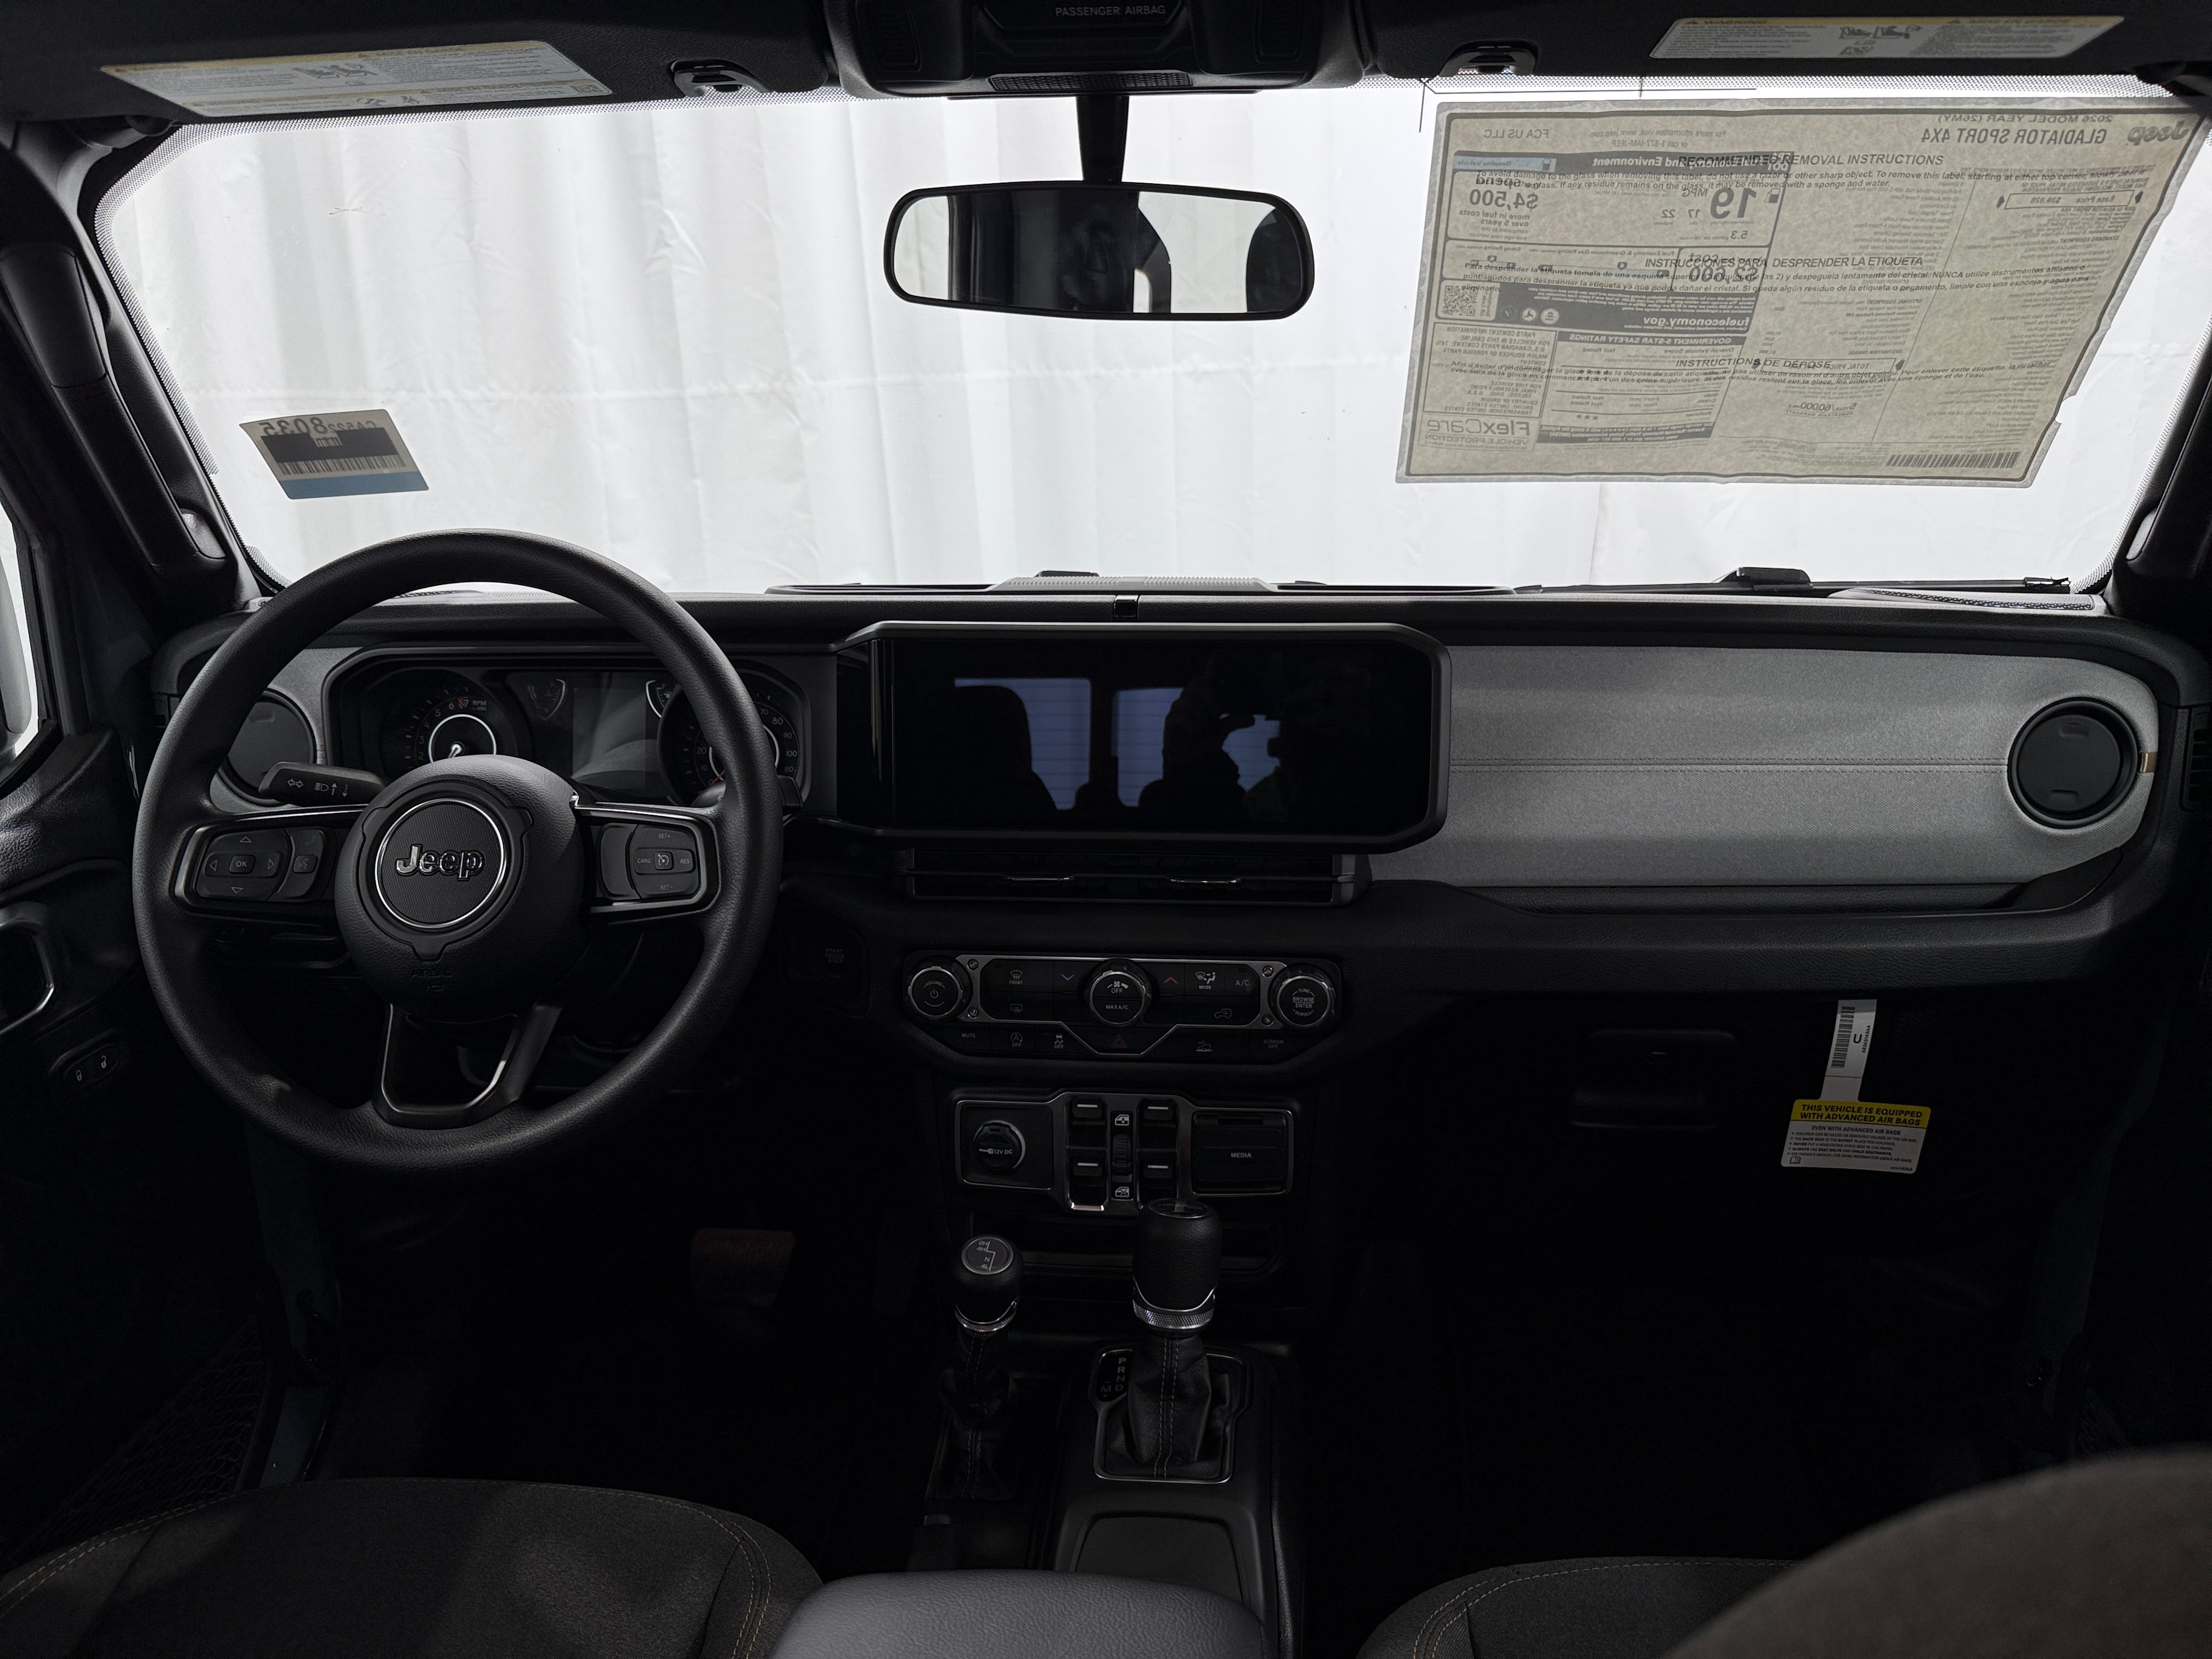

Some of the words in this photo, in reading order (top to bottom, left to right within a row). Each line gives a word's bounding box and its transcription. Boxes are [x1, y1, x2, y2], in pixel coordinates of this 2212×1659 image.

[1055, 7, 1120, 16] PASSENGER
[1125, 5, 1166, 14] AIRBAG
[1783, 155, 1844, 165] REMOVAL
[1847, 154, 1944, 166] INSTRUCTIONS
[1513, 172, 1545, 180] damage
[1573, 172, 1595, 180] glass
[1621, 172, 1661, 180] removing
[1819, 172, 1843, 181] sharp
[1845, 171, 1874, 180] object.
[1968, 173, 2001, 182] starting
[2041, 173, 2055, 182] top
[1568, 181, 1583, 190] any
[1617, 181, 1651, 189] remains
[1814, 180, 1846, 189] sponge
[1645, 258, 1735, 268] INSTRUCCIONES
[1773, 258, 1849, 268] DESPRENDER
[1851, 257, 1865, 267] LA
[1867, 257, 1923, 267] ETIQUETA
[1675, 358, 1760, 368] INSTRUCTIONS
[449, 702, 455, 710] 6
[435, 709, 441, 717] 5
[424, 721, 430, 729] 4
[772, 717, 784, 725] 80
[419, 736, 425, 744] 3
[418, 752, 424, 760] 2
[396, 843, 486, 882] Jeep
[1853, 1034, 1863, 1043] U
[1824, 1105, 1863, 1114] VEHICLE
[1875, 1108, 1923, 1118] EQUIPPED
[1825, 1113, 1876, 1122] ADVANCED
[1895, 1117, 1921, 1126] BAGS
